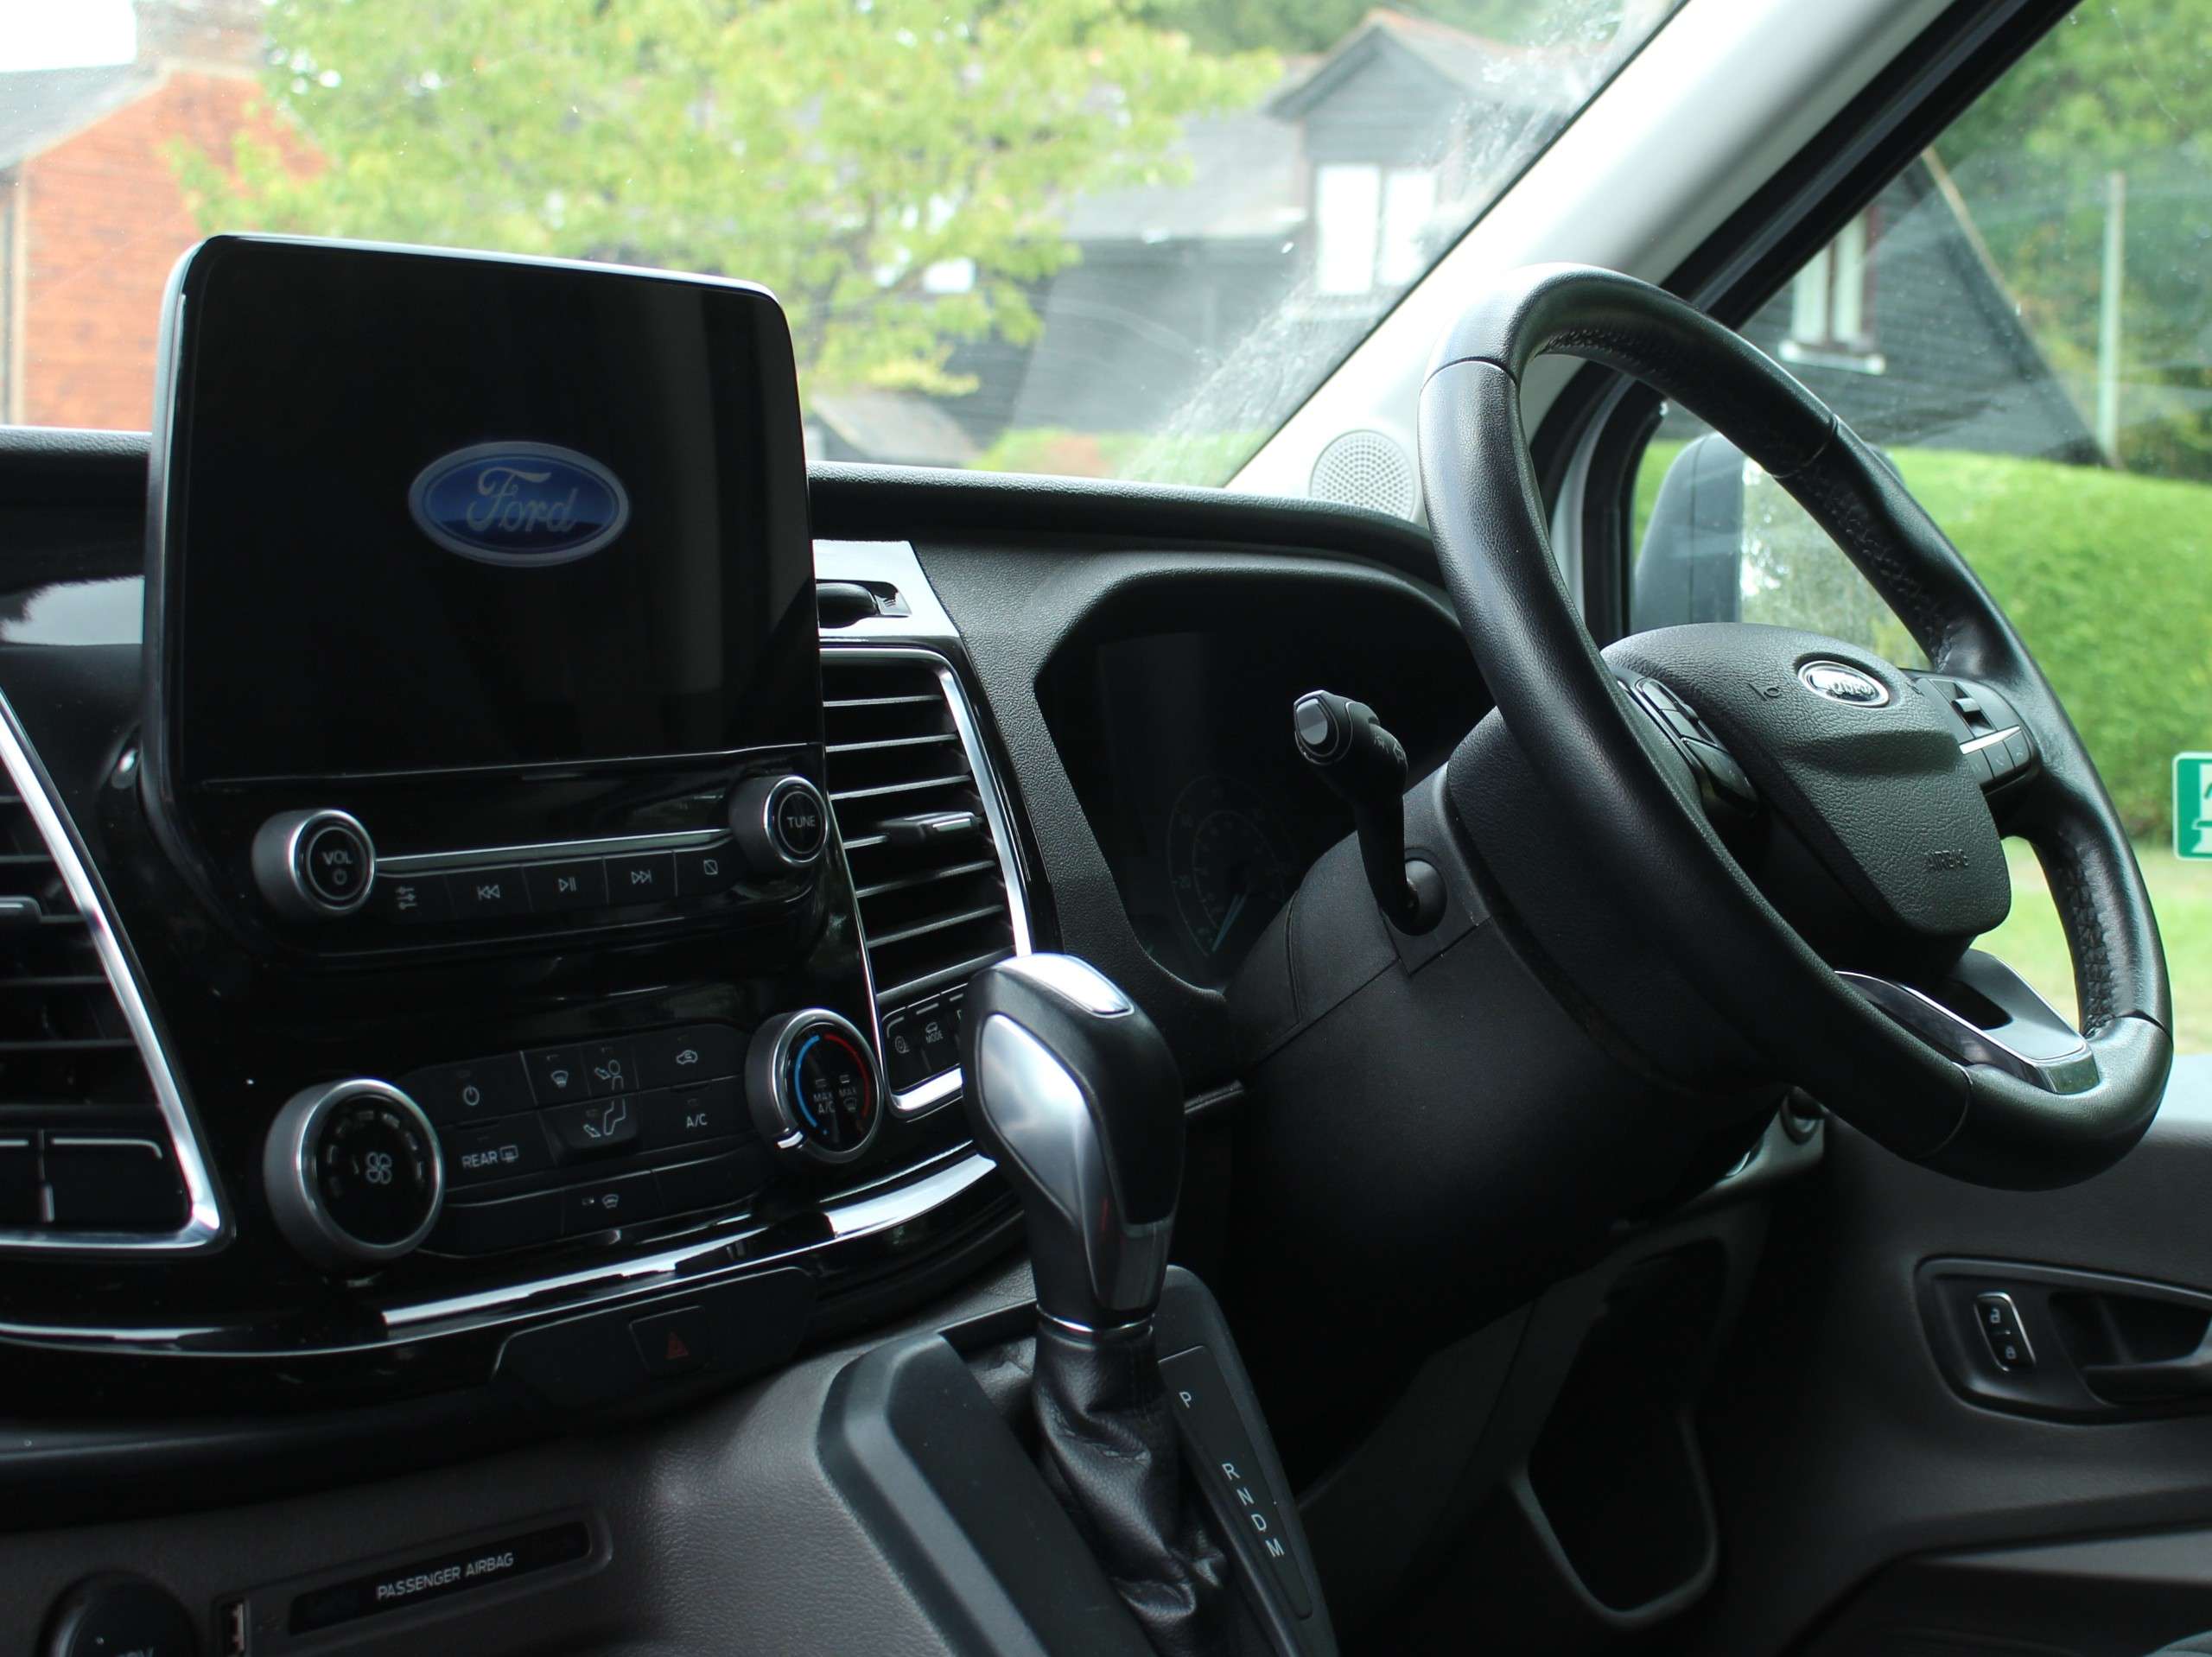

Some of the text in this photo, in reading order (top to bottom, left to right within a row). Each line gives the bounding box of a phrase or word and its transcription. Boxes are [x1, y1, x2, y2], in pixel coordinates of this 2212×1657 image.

[467, 467, 580, 532] Ford
[786, 816, 816, 828] TUNE
[321, 849, 353, 866] VOL
[813, 1092, 834, 1101] MAX
[817, 1101, 836, 1114] A/C
[686, 1114, 708, 1128] A/C
[461, 1150, 499, 1169] REAR
[1179, 1391, 1192, 1408] P
[1221, 1462, 1241, 1481] R
[1236, 1488, 1255, 1506] N
[1250, 1513, 1267, 1532] D
[1265, 1537, 1285, 1558] M
[376, 1552, 514, 1601] PASSENGER AIRBAG
